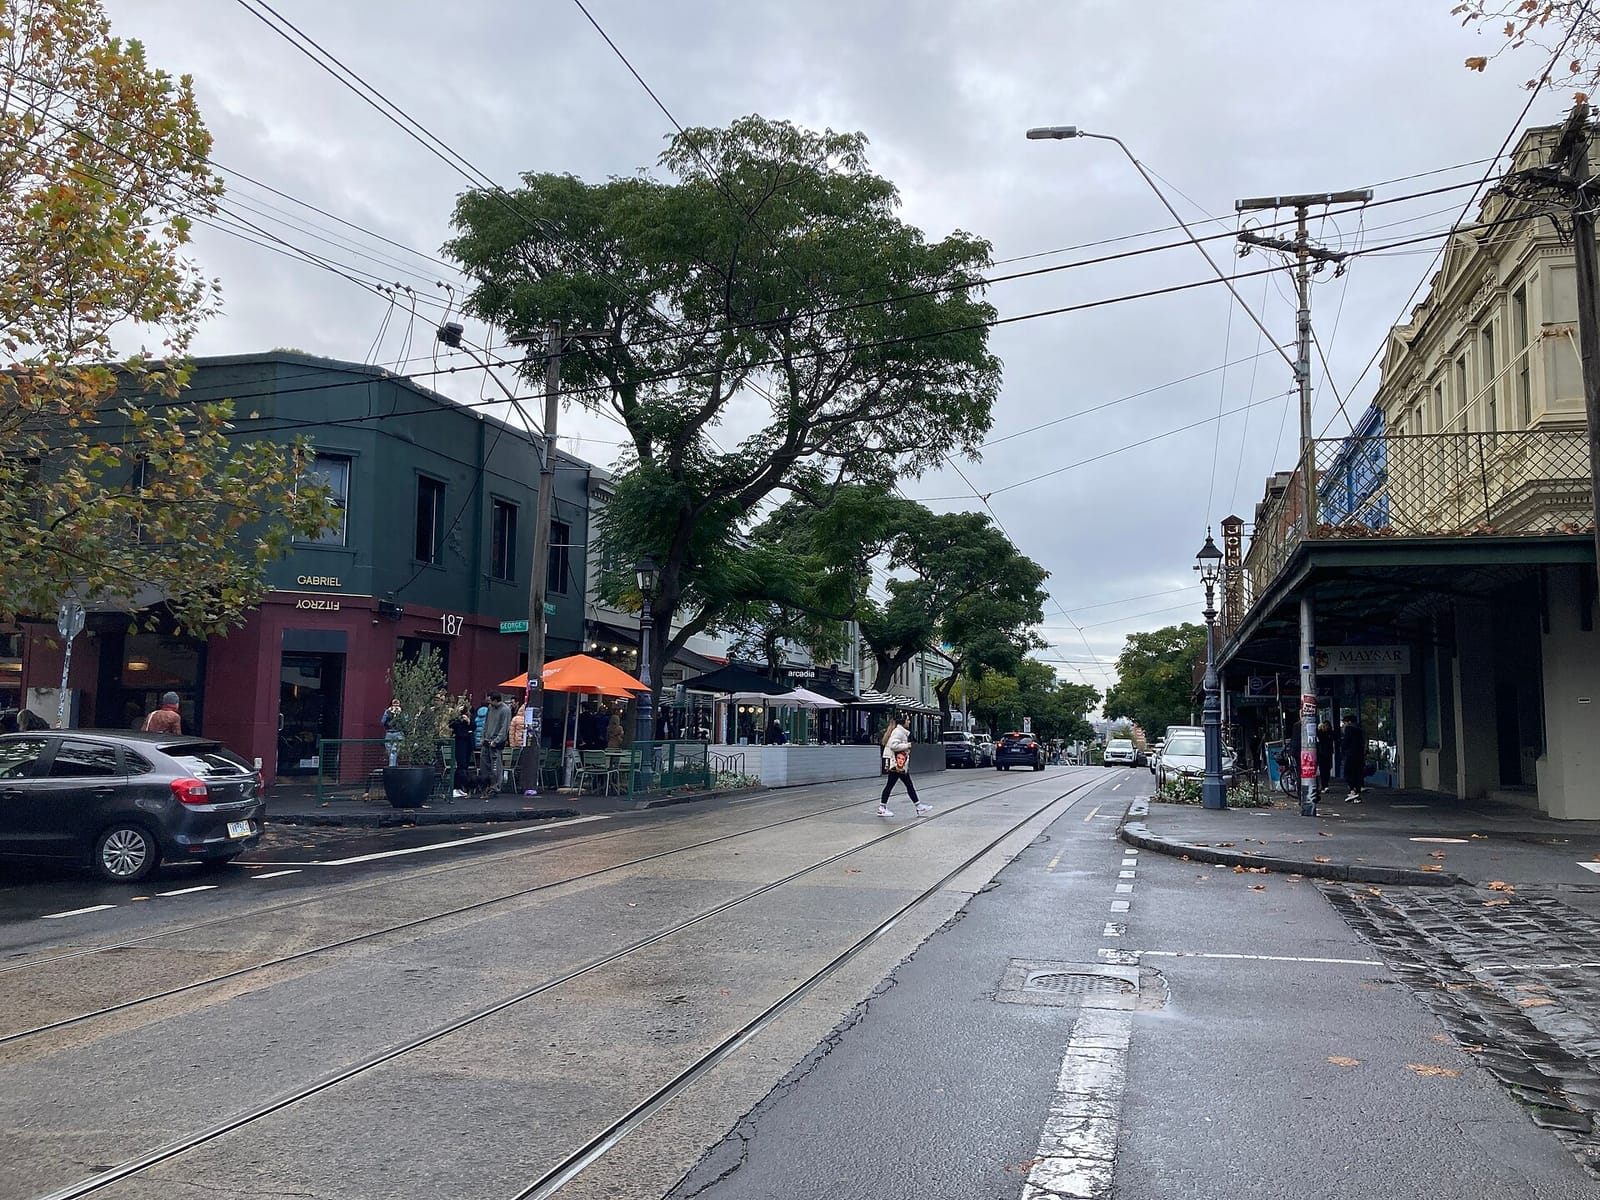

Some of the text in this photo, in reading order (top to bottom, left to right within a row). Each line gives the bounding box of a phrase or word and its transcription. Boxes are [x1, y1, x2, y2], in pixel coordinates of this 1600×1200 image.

[297, 575, 342, 587] GABRIEL
[295, 599, 340, 611] FITZROY
[440, 613, 464, 636] 187
[500, 621, 523, 630] GEORGE
[1339, 650, 1402, 661] MAYSAR
[787, 669, 815, 678] arcadia
